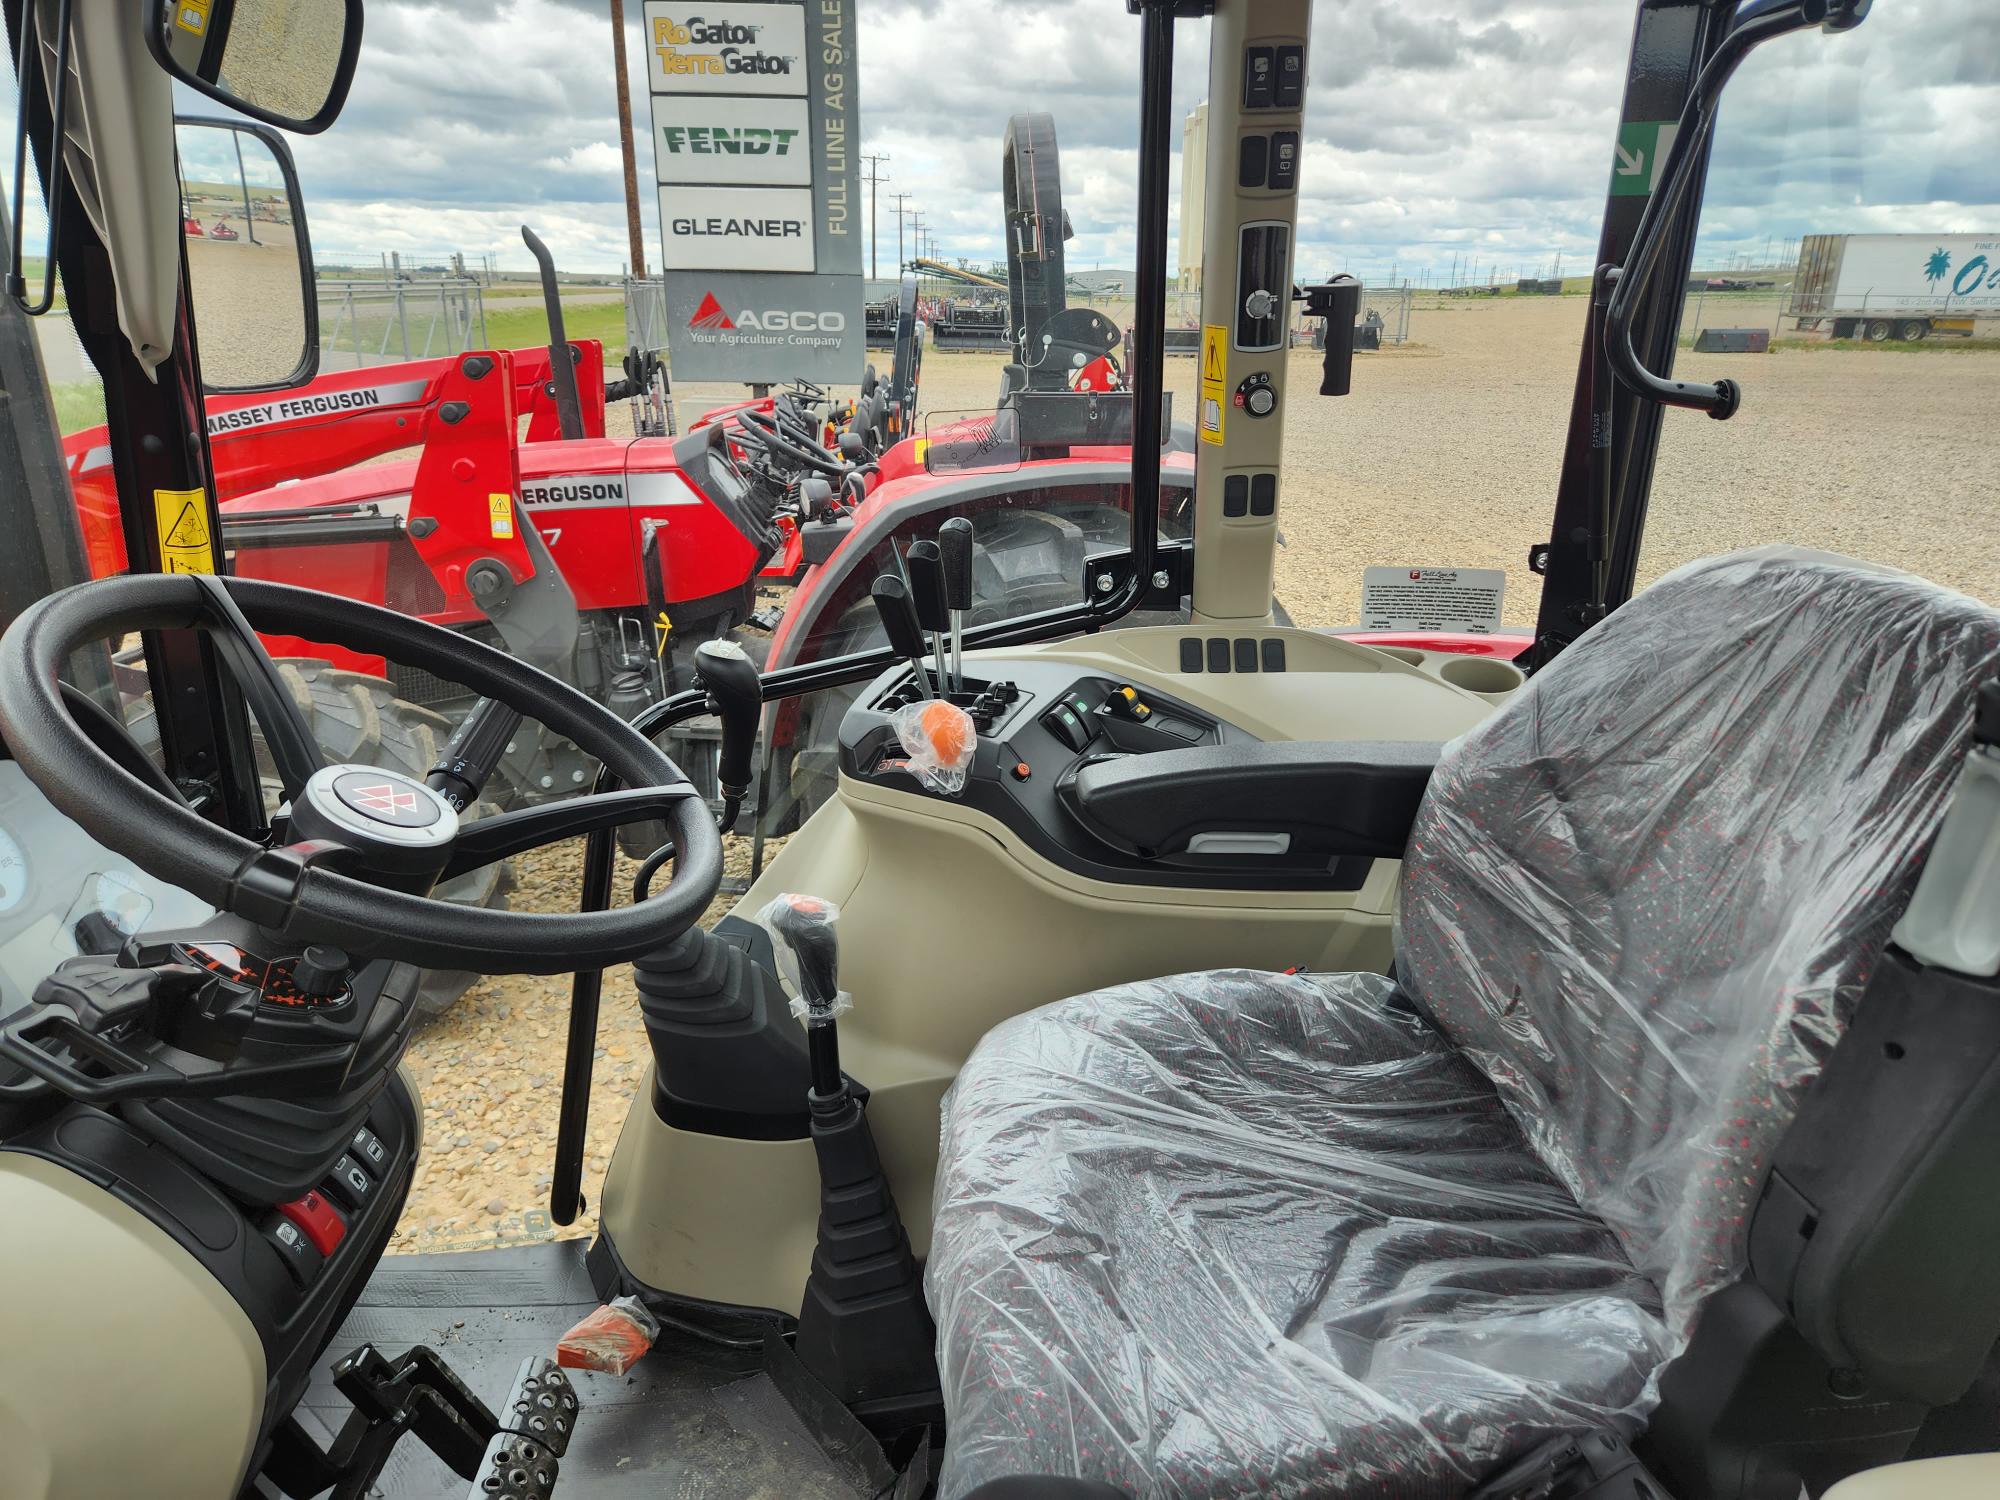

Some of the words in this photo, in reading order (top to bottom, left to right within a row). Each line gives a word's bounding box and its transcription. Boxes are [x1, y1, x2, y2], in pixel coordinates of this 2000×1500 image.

[653, 16, 761, 45] RoGator
[656, 46, 796, 75] TerraGator
[824, 73, 844, 111] AG
[662, 126, 799, 156] FENDT
[825, 119, 846, 171] LINE
[828, 179, 848, 235] FULL
[672, 218, 801, 237] GLEANER
[735, 310, 845, 332] AGCO
[690, 333, 716, 344] Your
[719, 333, 785, 346] Agriculture
[788, 334, 842, 349] Company
[207, 407, 273, 434] MASSEY
[280, 390, 379, 418] FERGUSON
[522, 484, 623, 505] ERGUSON
